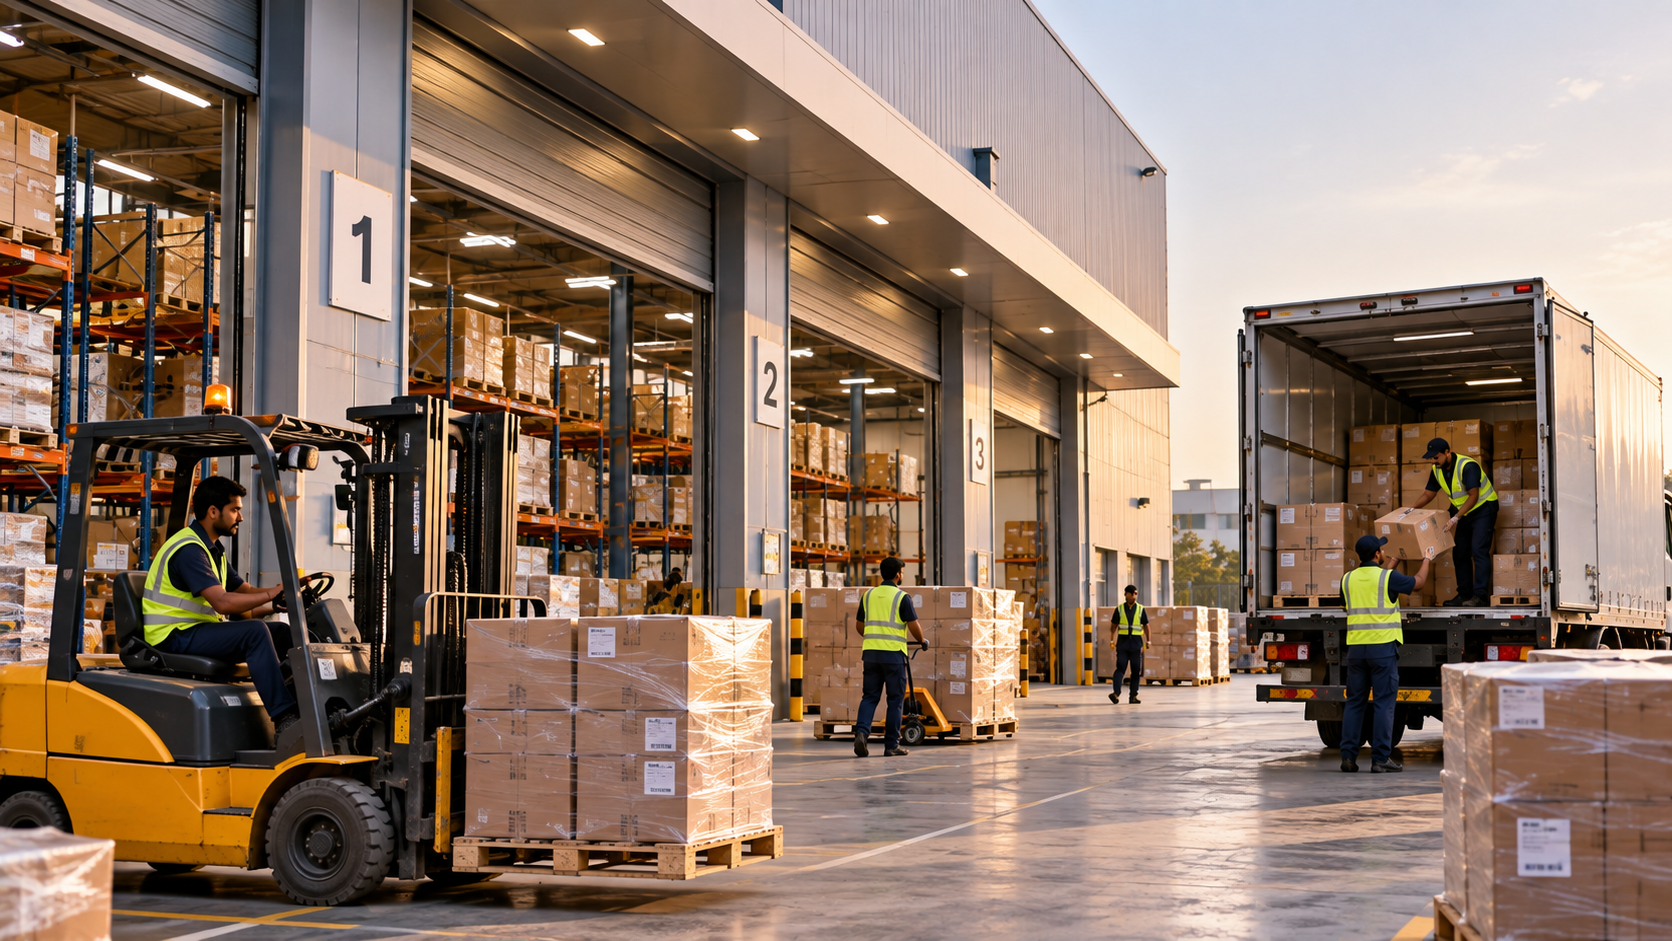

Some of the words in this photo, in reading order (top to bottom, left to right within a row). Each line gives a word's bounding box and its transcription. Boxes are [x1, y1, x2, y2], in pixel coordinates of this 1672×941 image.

[352, 215, 372, 284] 1
[763, 361, 778, 408] 2
[975, 437, 985, 470] 3
